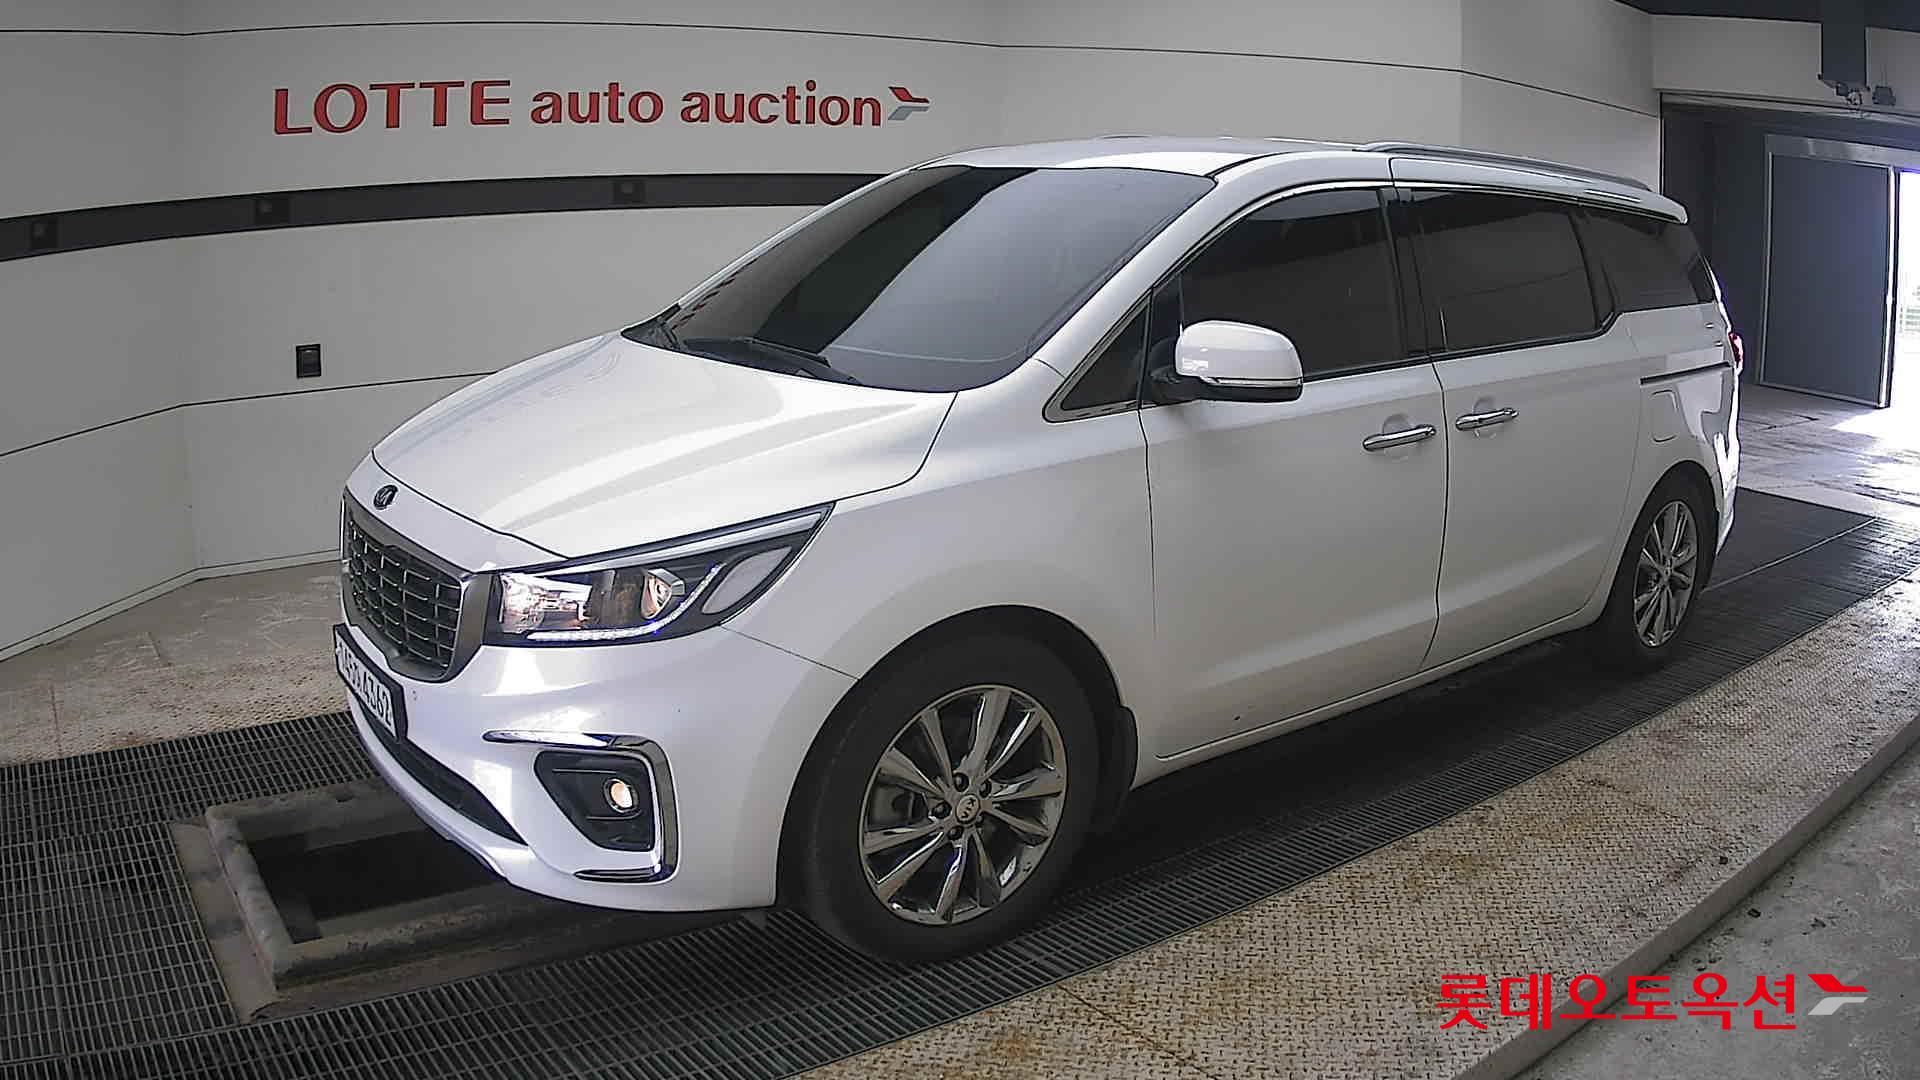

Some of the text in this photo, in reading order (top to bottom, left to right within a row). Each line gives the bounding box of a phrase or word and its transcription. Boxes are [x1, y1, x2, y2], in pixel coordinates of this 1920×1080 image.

[273, 80, 882, 135] LOTTE auto auction
